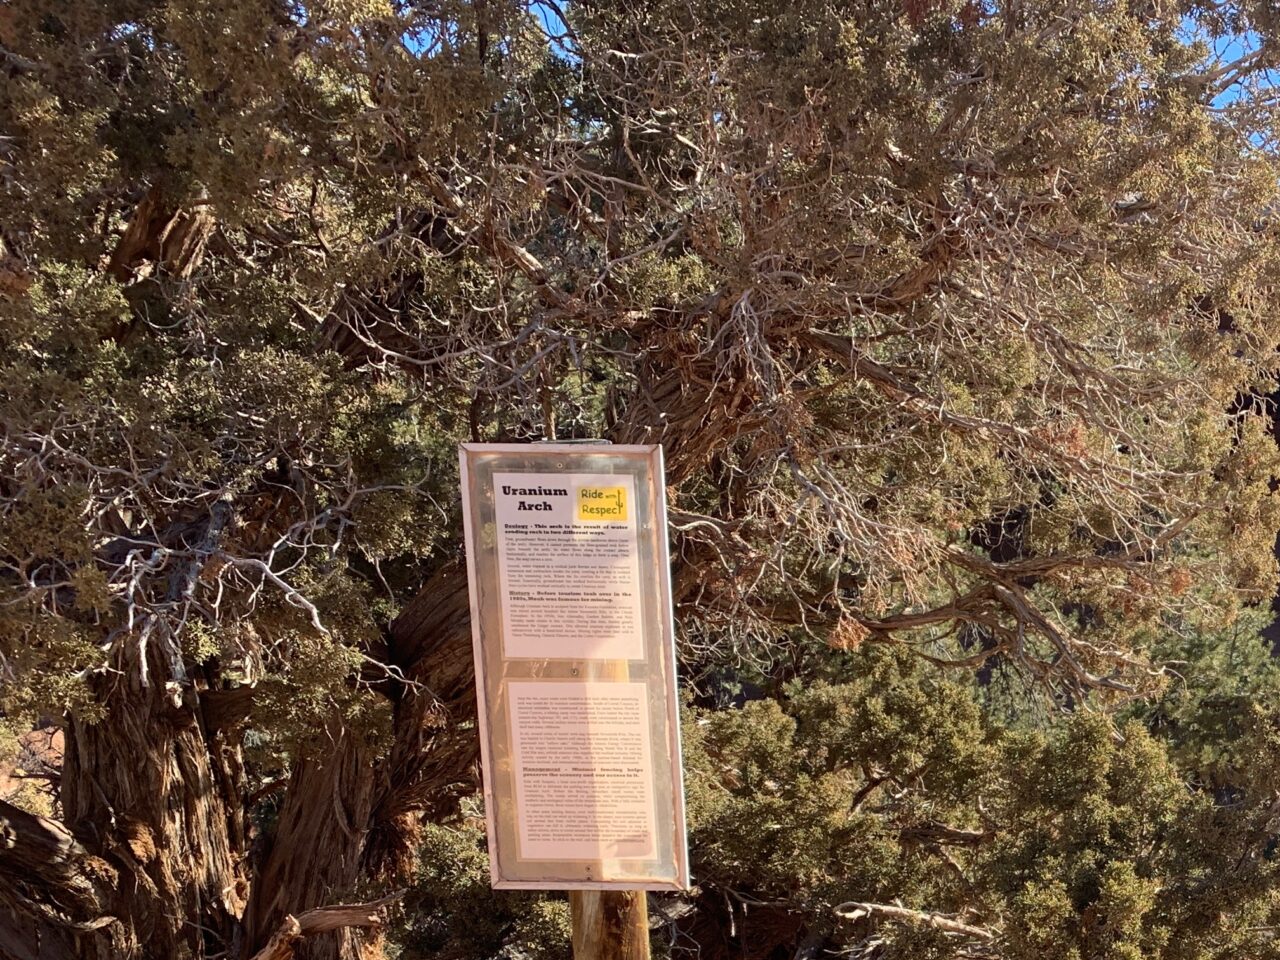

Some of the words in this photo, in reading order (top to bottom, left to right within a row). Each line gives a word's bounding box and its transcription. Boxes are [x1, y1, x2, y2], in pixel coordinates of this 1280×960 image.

[502, 486, 568, 496] Uranium
[581, 489, 604, 499] Ride
[518, 501, 552, 511] Arch
